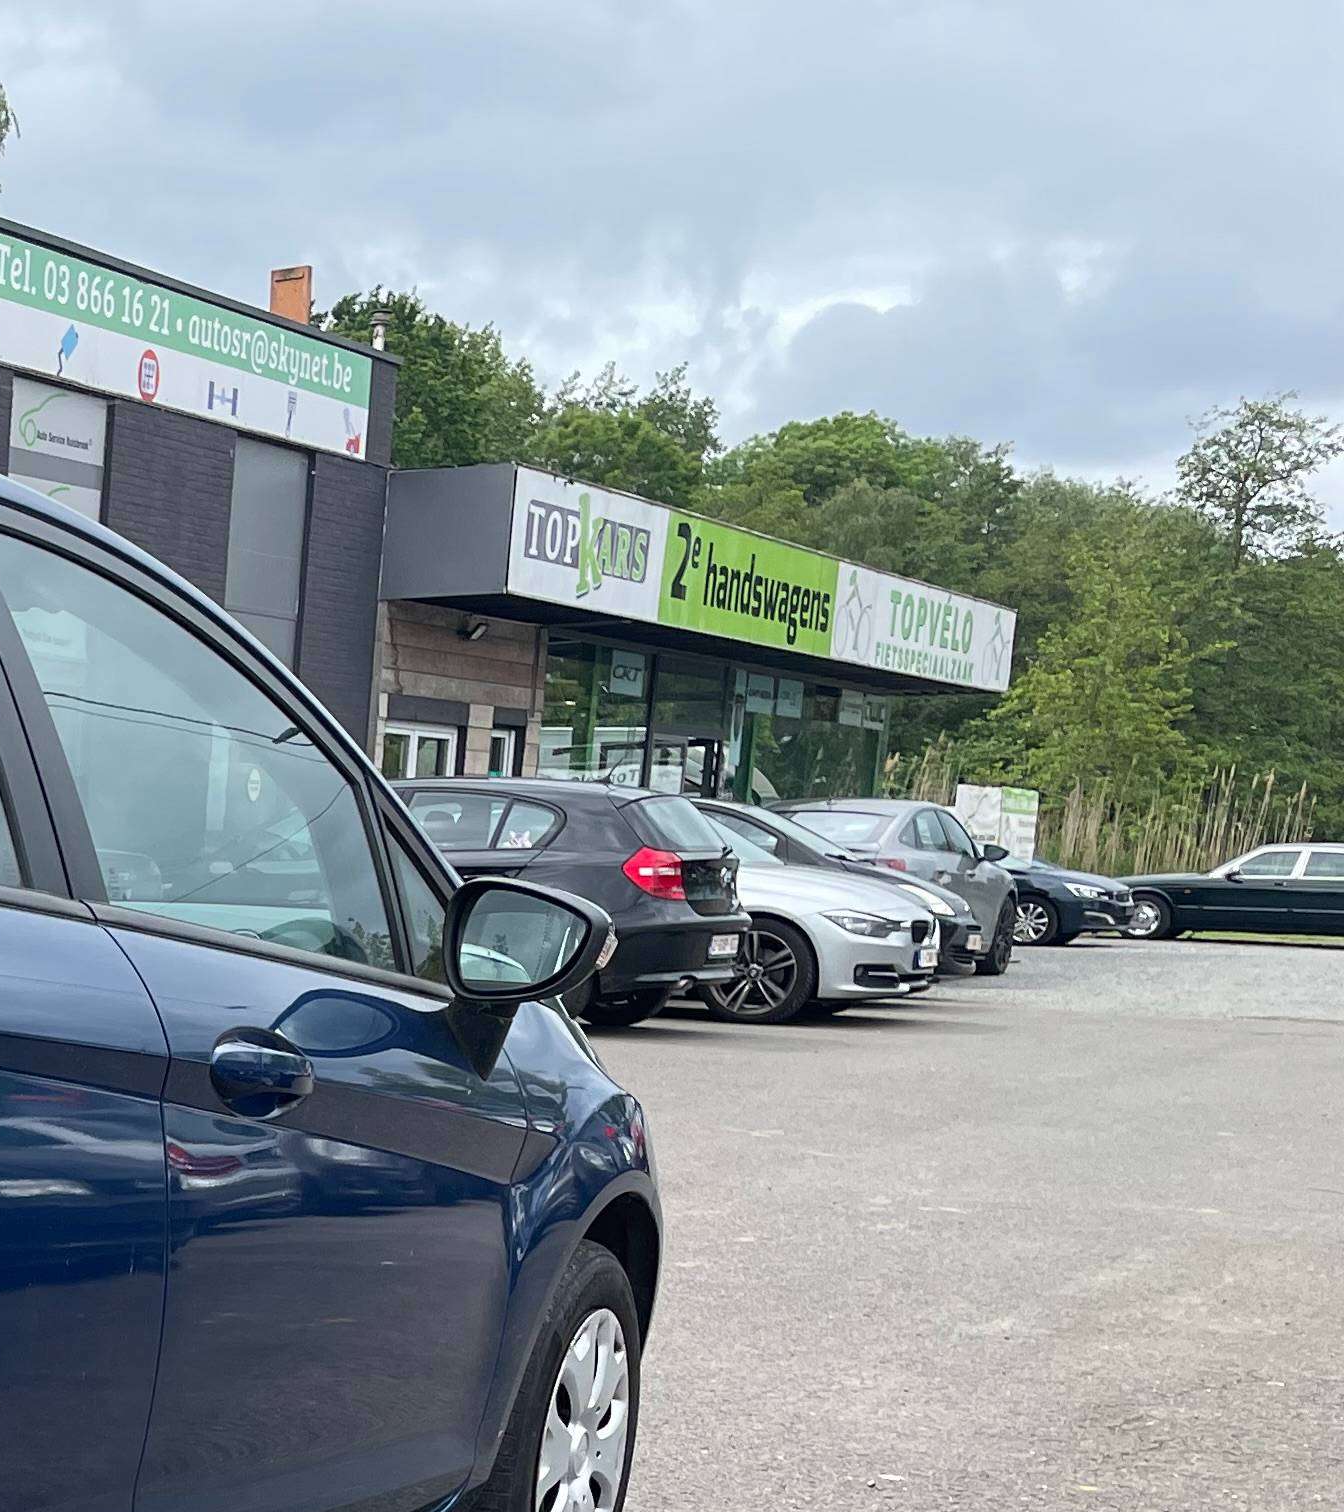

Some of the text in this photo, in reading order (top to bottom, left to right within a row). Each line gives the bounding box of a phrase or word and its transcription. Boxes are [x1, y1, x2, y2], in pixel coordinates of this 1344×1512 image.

[44, 260, 69, 305] 03
[76, 271, 115, 318] 866
[122, 285, 144, 327] 16
[148, 294, 170, 336] 21
[189, 316, 353, 394] autosr@skynet.be
[703, 543, 831, 645] handswagens
[891, 590, 973, 654] TOPVÉLO
[875, 642, 974, 683] FIETSSPECIAALZAAK
